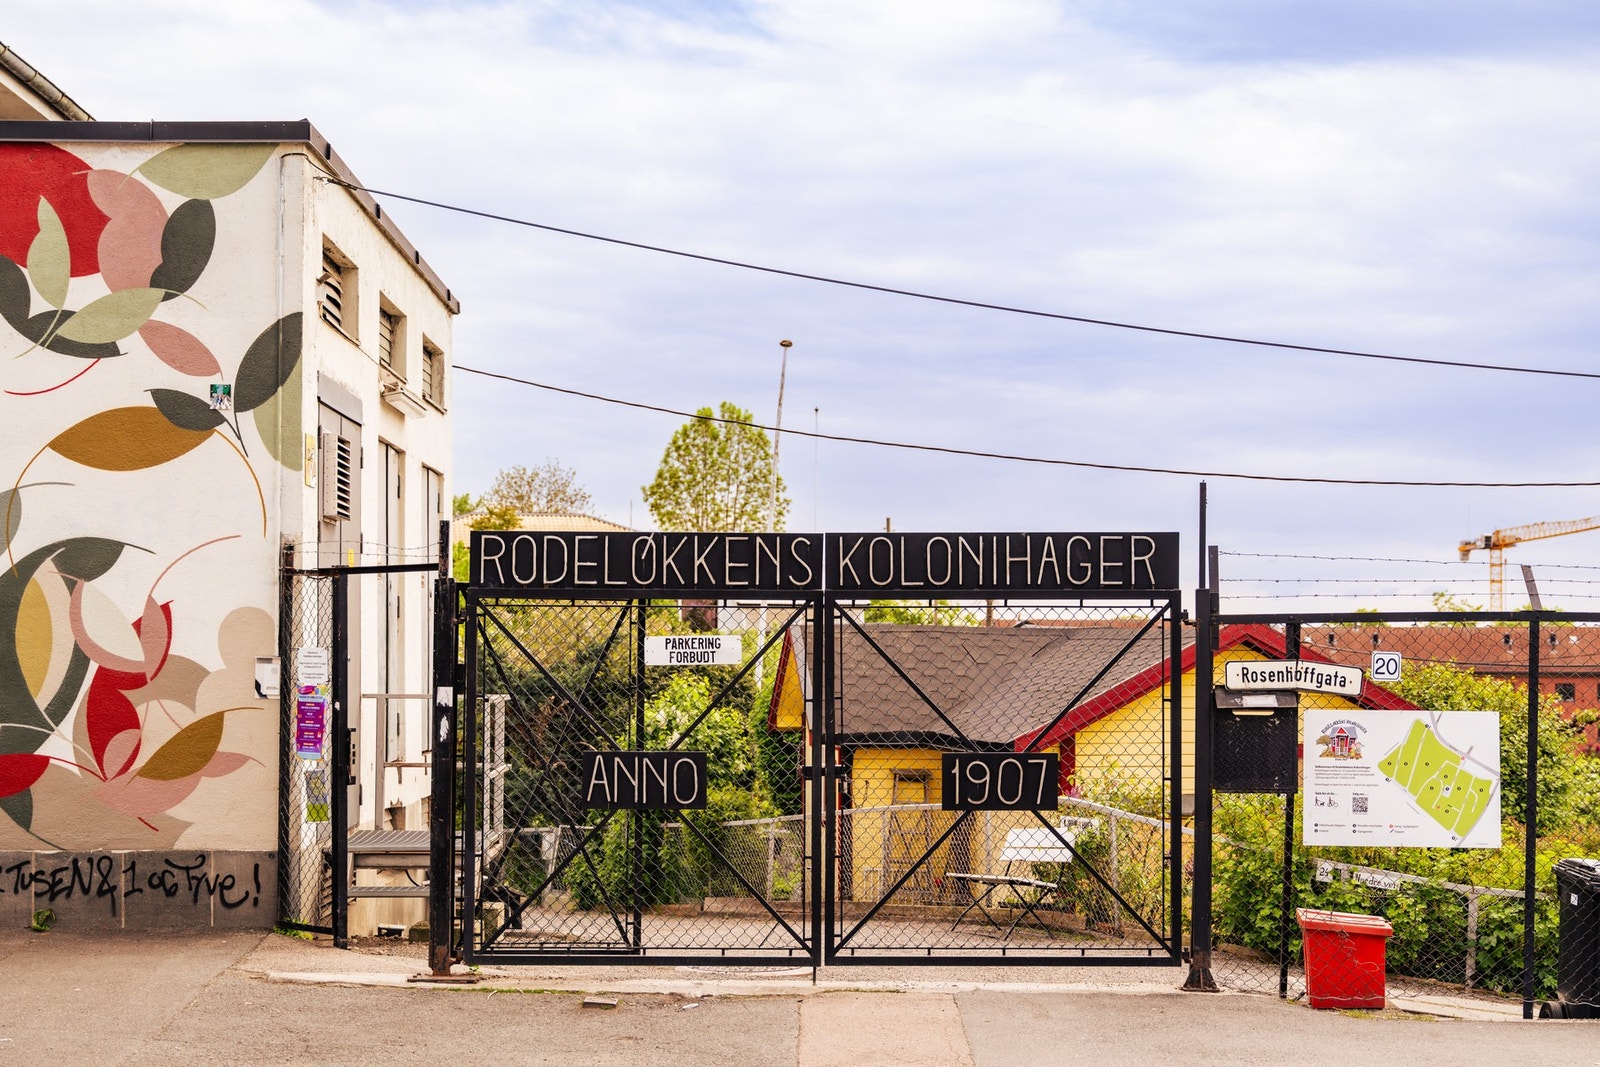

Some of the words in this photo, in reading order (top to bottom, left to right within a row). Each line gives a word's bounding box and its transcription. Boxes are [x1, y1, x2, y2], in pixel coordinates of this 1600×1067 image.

[480, 533, 813, 586] RODELØKKENS
[839, 535, 1156, 586] KOLONIHAGER
[665, 637, 721, 650] PARKERING
[669, 651, 716, 663] FORBUDT
[1374, 657, 1398, 675] 20
[1241, 666, 1347, 688] Rosenhoffgata
[587, 754, 698, 805] ANNO
[951, 758, 1048, 805] 1907
